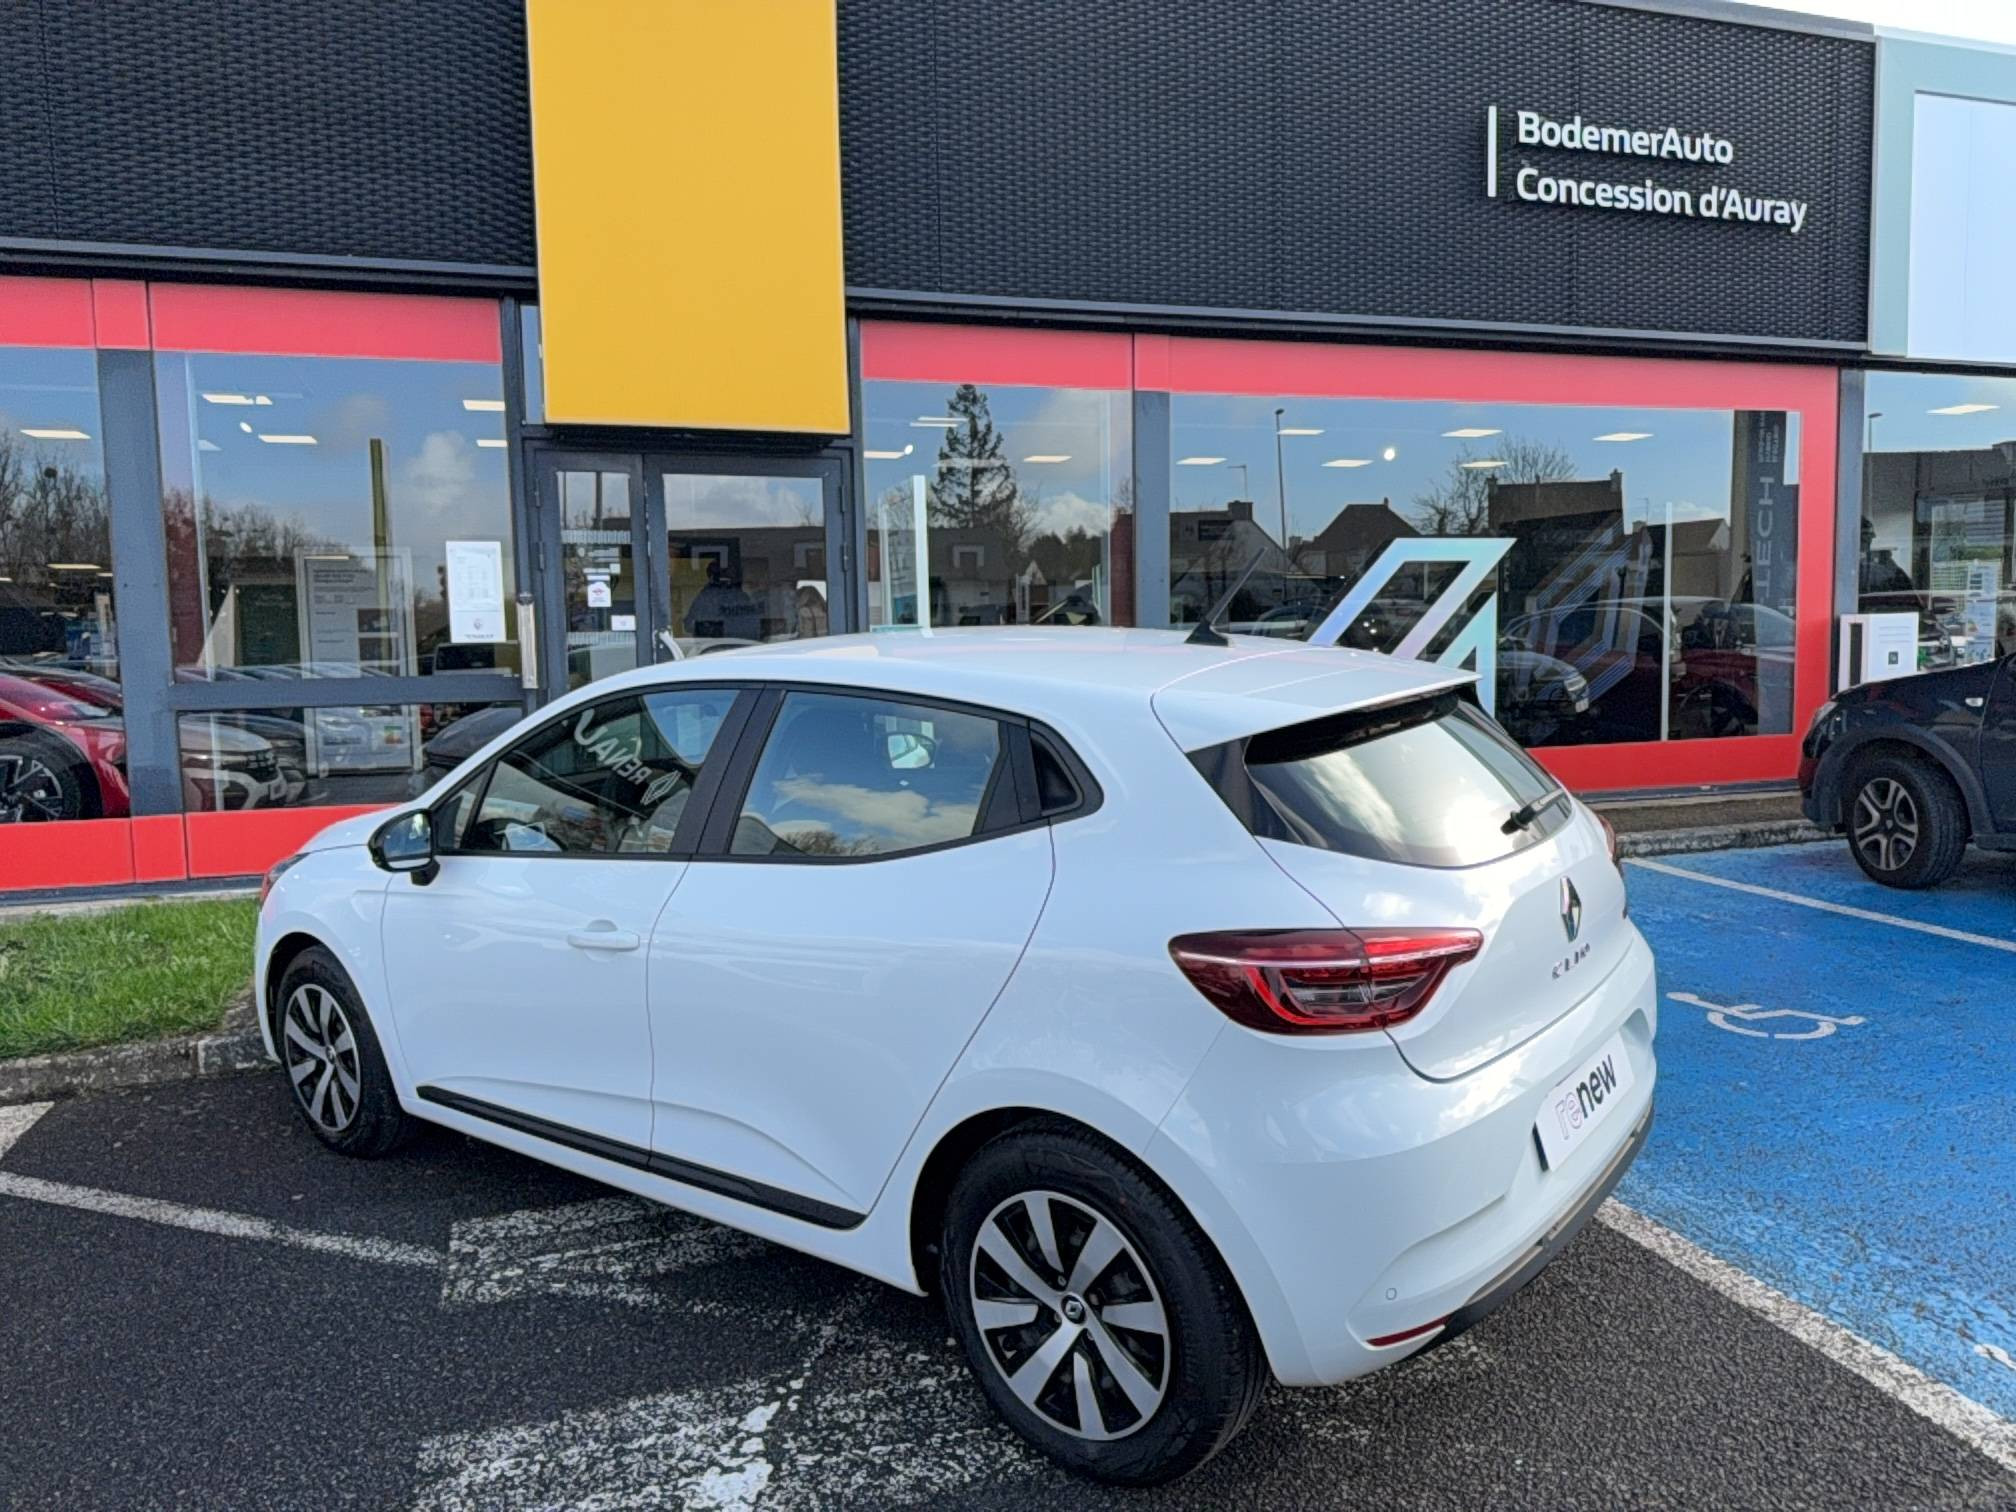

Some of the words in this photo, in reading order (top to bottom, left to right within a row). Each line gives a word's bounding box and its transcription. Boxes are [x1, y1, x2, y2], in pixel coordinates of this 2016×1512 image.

[1516, 110, 1734, 165] BodemerAuto
[1516, 167, 1694, 216] Concession
[1699, 186, 1808, 233] d'Auray
[1554, 1054, 1617, 1140] renew
